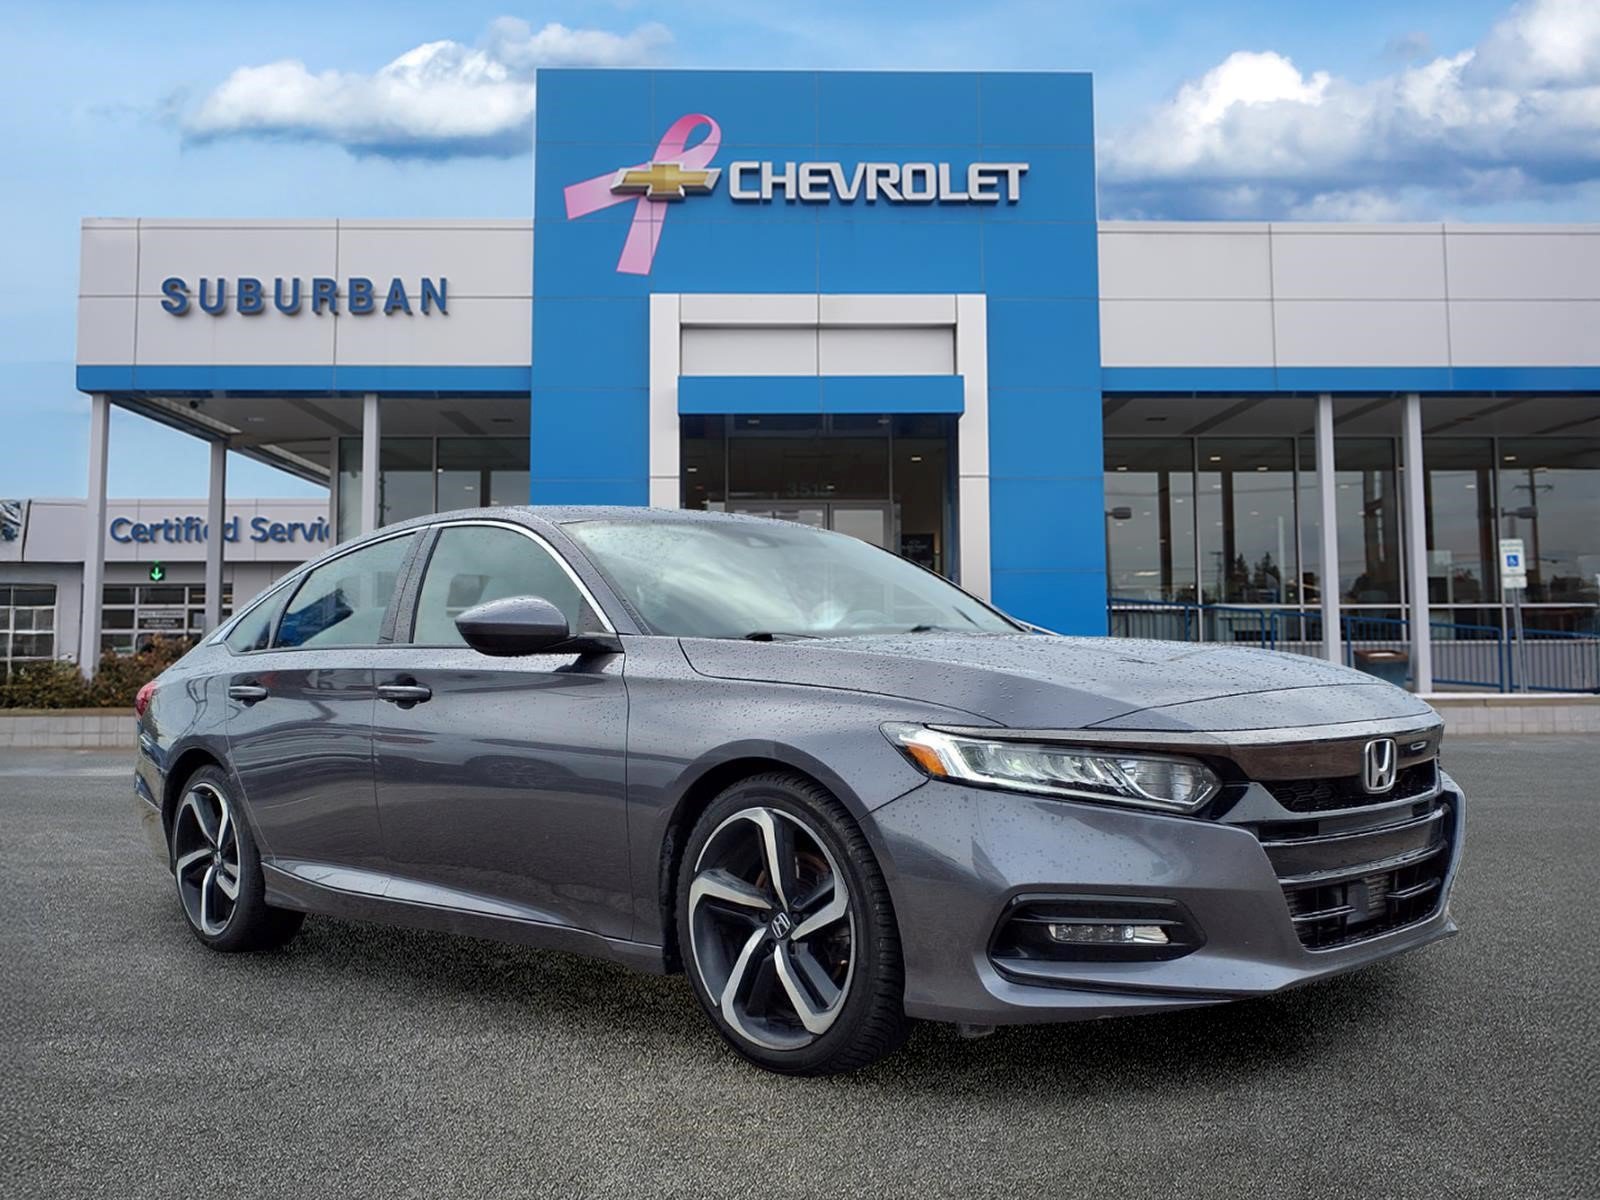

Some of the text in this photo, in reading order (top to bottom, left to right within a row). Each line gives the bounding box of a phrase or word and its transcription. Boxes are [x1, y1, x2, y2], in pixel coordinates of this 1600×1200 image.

[729, 161, 1029, 201] CHEVROLET
[161, 277, 449, 315] SUBURBAN
[110, 516, 239, 543] Certifid
